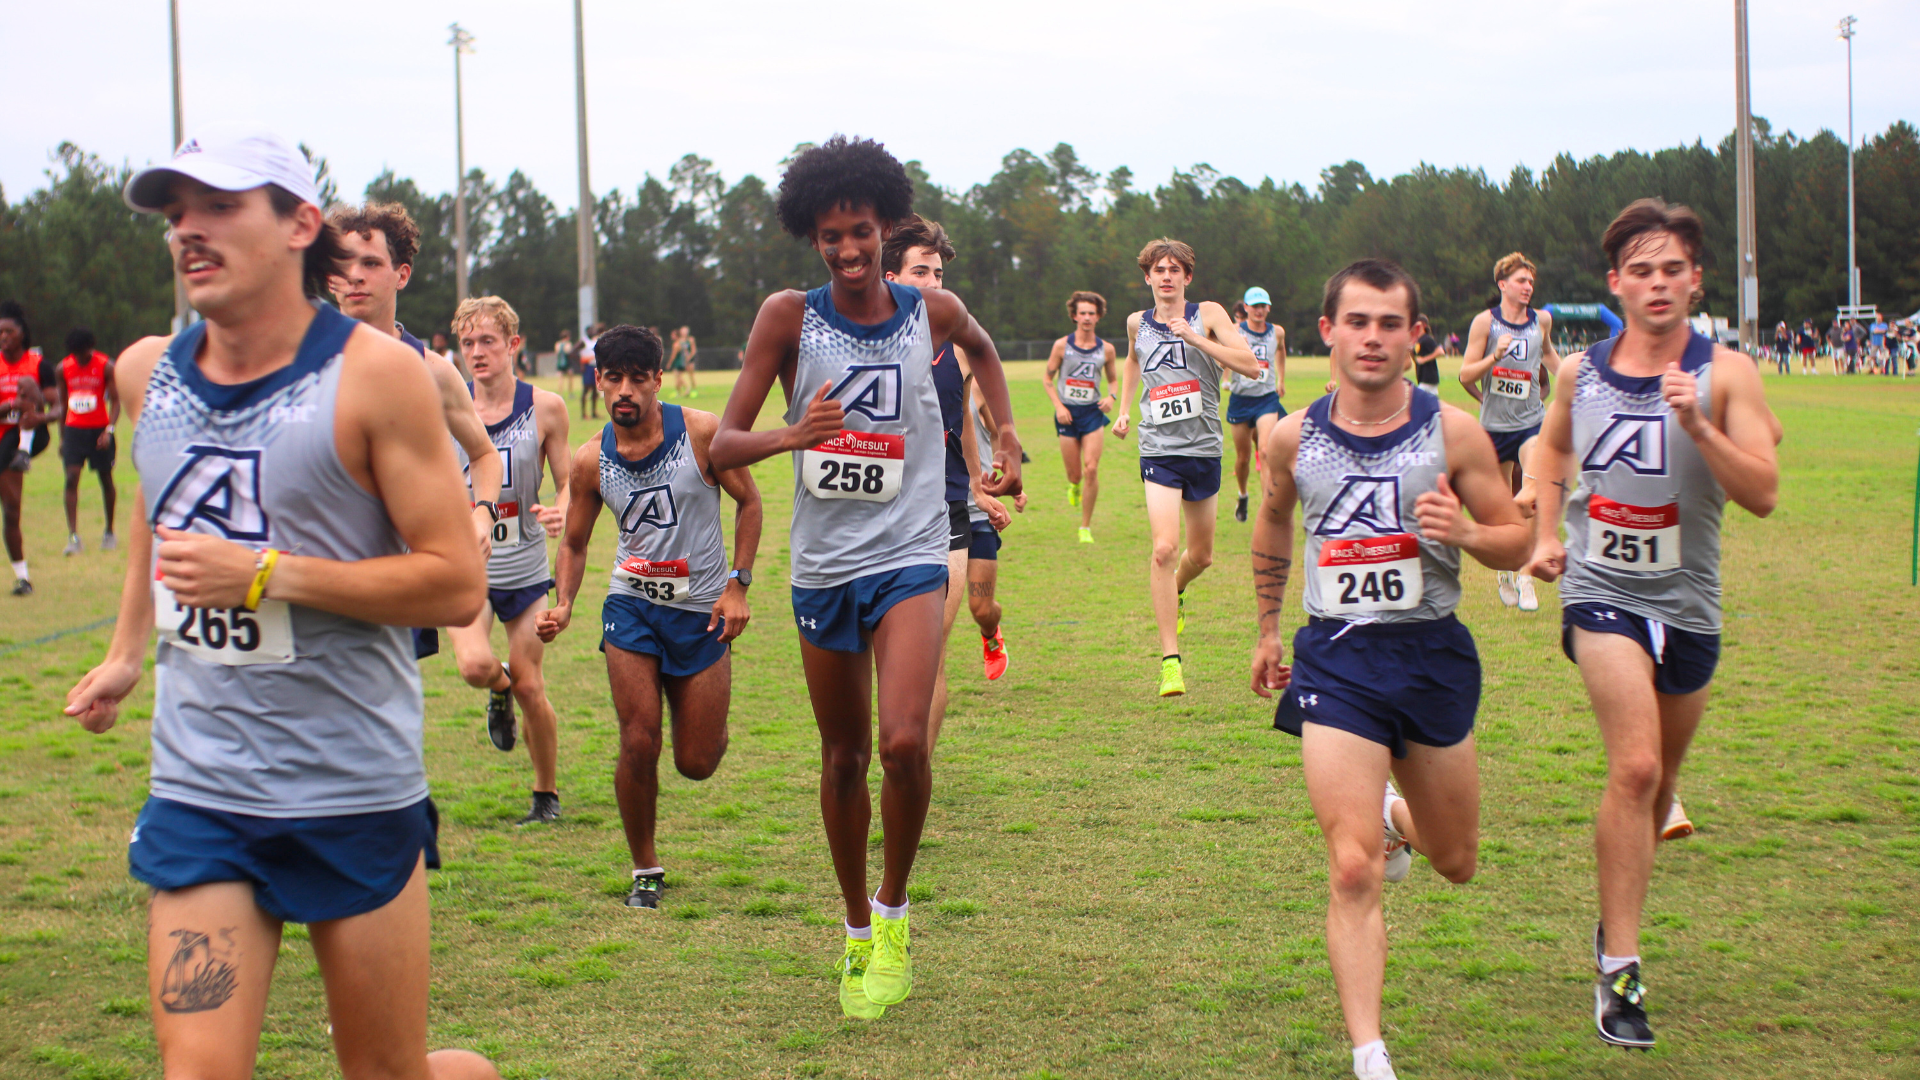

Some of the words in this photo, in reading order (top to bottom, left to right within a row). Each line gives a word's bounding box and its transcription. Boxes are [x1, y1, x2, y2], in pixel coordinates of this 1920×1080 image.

[1068, 361, 1097, 379] A
[1143, 340, 1187, 373] A
[820, 361, 903, 424] A
[1070, 388, 1088, 399] 252
[1497, 380, 1523, 395] 266
[1160, 397, 1192, 419] 261
[510, 430, 534, 441] PBC
[857, 440, 890, 452] RESULT
[1581, 411, 1670, 477] A
[665, 457, 689, 471] PBC
[1397, 452, 1439, 467] PBC
[818, 460, 884, 494] 258
[151, 441, 272, 544] A
[1314, 474, 1407, 537] A
[620, 482, 680, 535] A
[1330, 548, 1355, 559] RACE
[1366, 543, 1401, 557] RESULT
[1602, 530, 1659, 563] 251
[628, 577, 675, 600] 263
[1338, 569, 1405, 605] 246
[176, 603, 260, 652] 265
